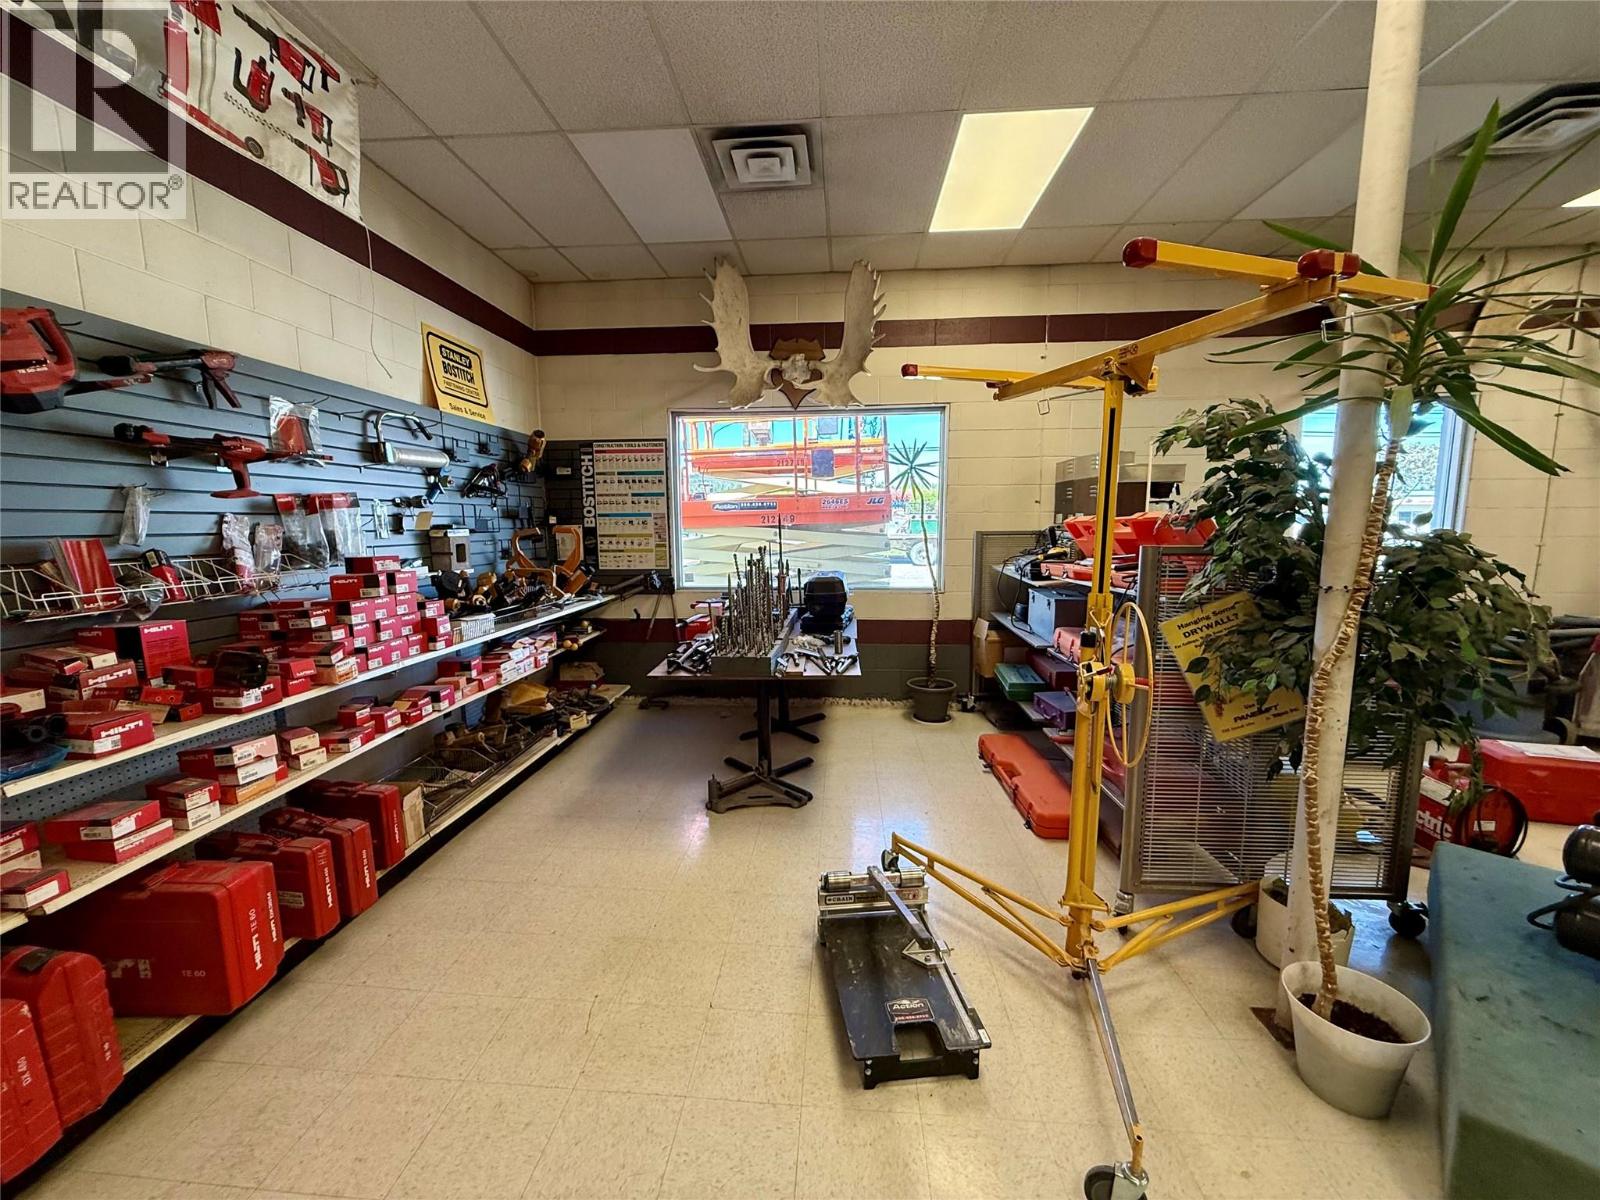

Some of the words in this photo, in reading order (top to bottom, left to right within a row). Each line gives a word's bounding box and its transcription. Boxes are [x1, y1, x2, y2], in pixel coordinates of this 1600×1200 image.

[441, 346, 471, 367] STANLEY
[441, 360, 475, 385] BOSTITCH
[448, 402, 464, 413] Sales
[469, 408, 487, 420] Service
[581, 454, 596, 528] BOSTITCH
[713, 503, 739, 511] Action
[144, 624, 174, 634] HILTI
[1176, 614, 1211, 630] Hanging
[1183, 612, 1239, 639] DRYWALL?
[88, 667, 132, 686] HILTI
[101, 719, 144, 738] HILTI
[1416, 809, 1453, 838] ctric
[325, 884, 333, 908] HILTI
[833, 894, 853, 903] CRAIN
[248, 908, 256, 920] 60
[250, 920, 258, 932] TE
[252, 933, 262, 971] HILTI
[892, 1001, 925, 1011] Action
[21, 1071, 32, 1087] DX
